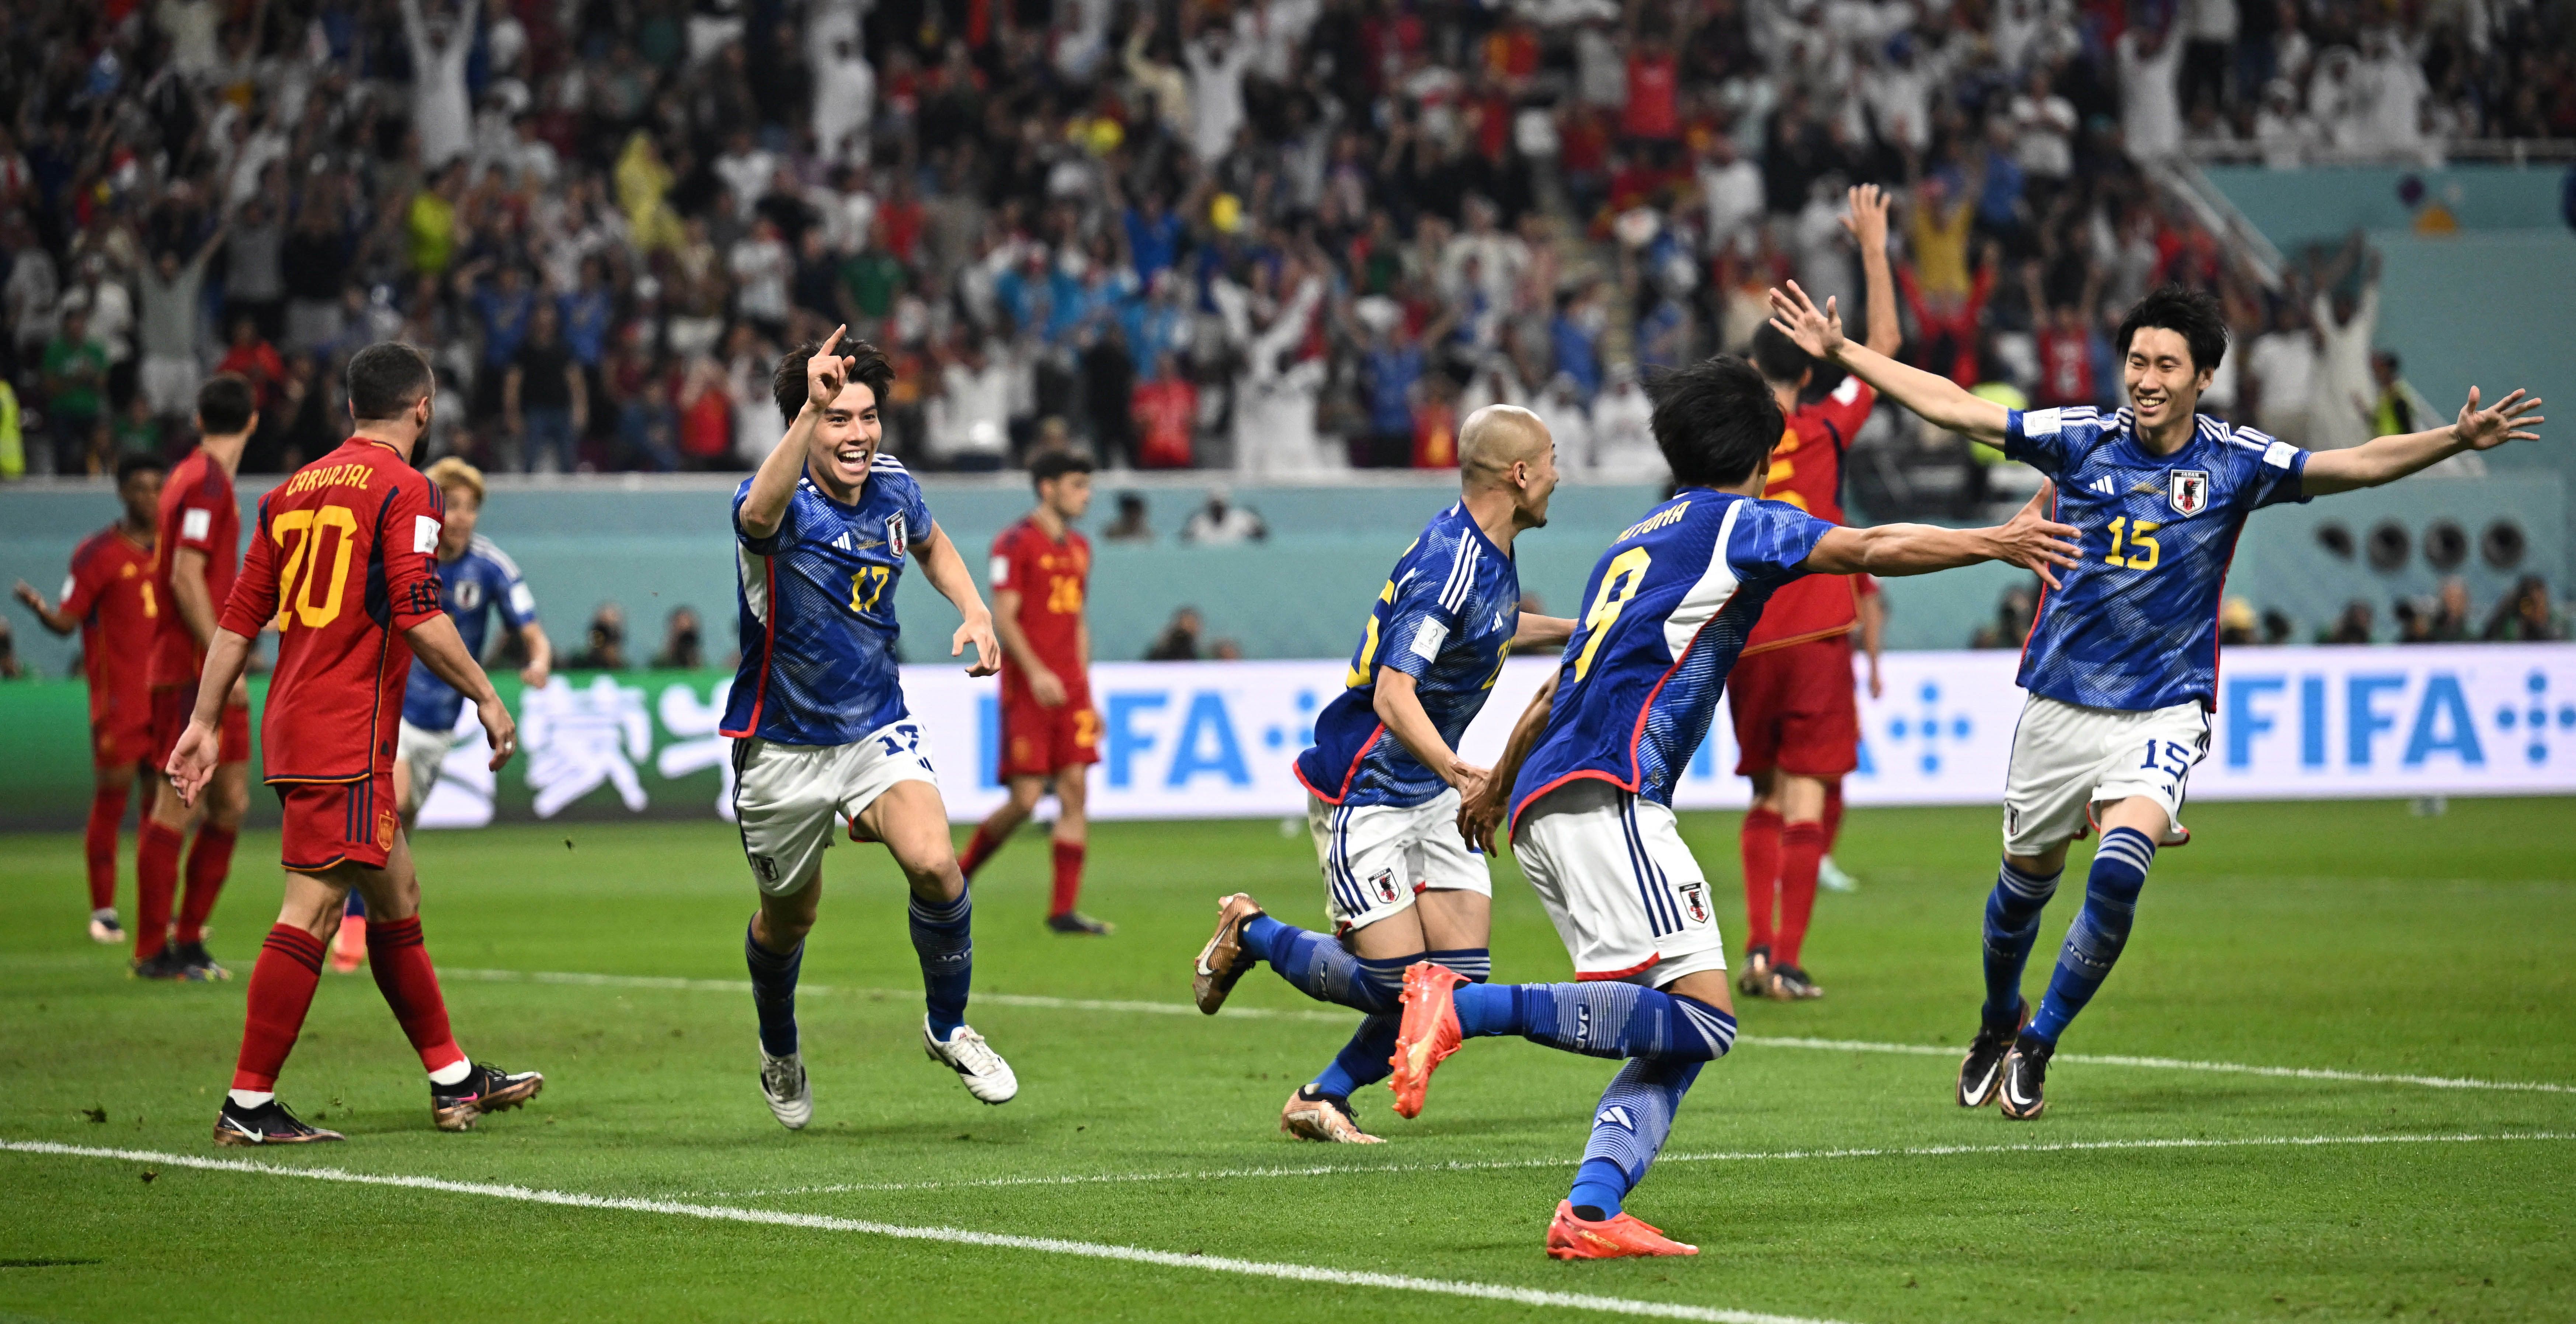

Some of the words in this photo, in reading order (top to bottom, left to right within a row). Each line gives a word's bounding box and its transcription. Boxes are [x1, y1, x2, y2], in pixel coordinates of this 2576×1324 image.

[286, 464, 373, 497] CARVAJAL
[2105, 516, 2160, 571] 15
[272, 505, 358, 632] 20
[849, 566, 890, 613] 17
[1574, 546, 1651, 683] 9
[1480, 639, 1515, 690] 2
[877, 724, 919, 757] 17
[2228, 674, 2486, 768] FIFA
[2140, 739, 2189, 782] 15
[1576, 1006, 1589, 1049] JAP
